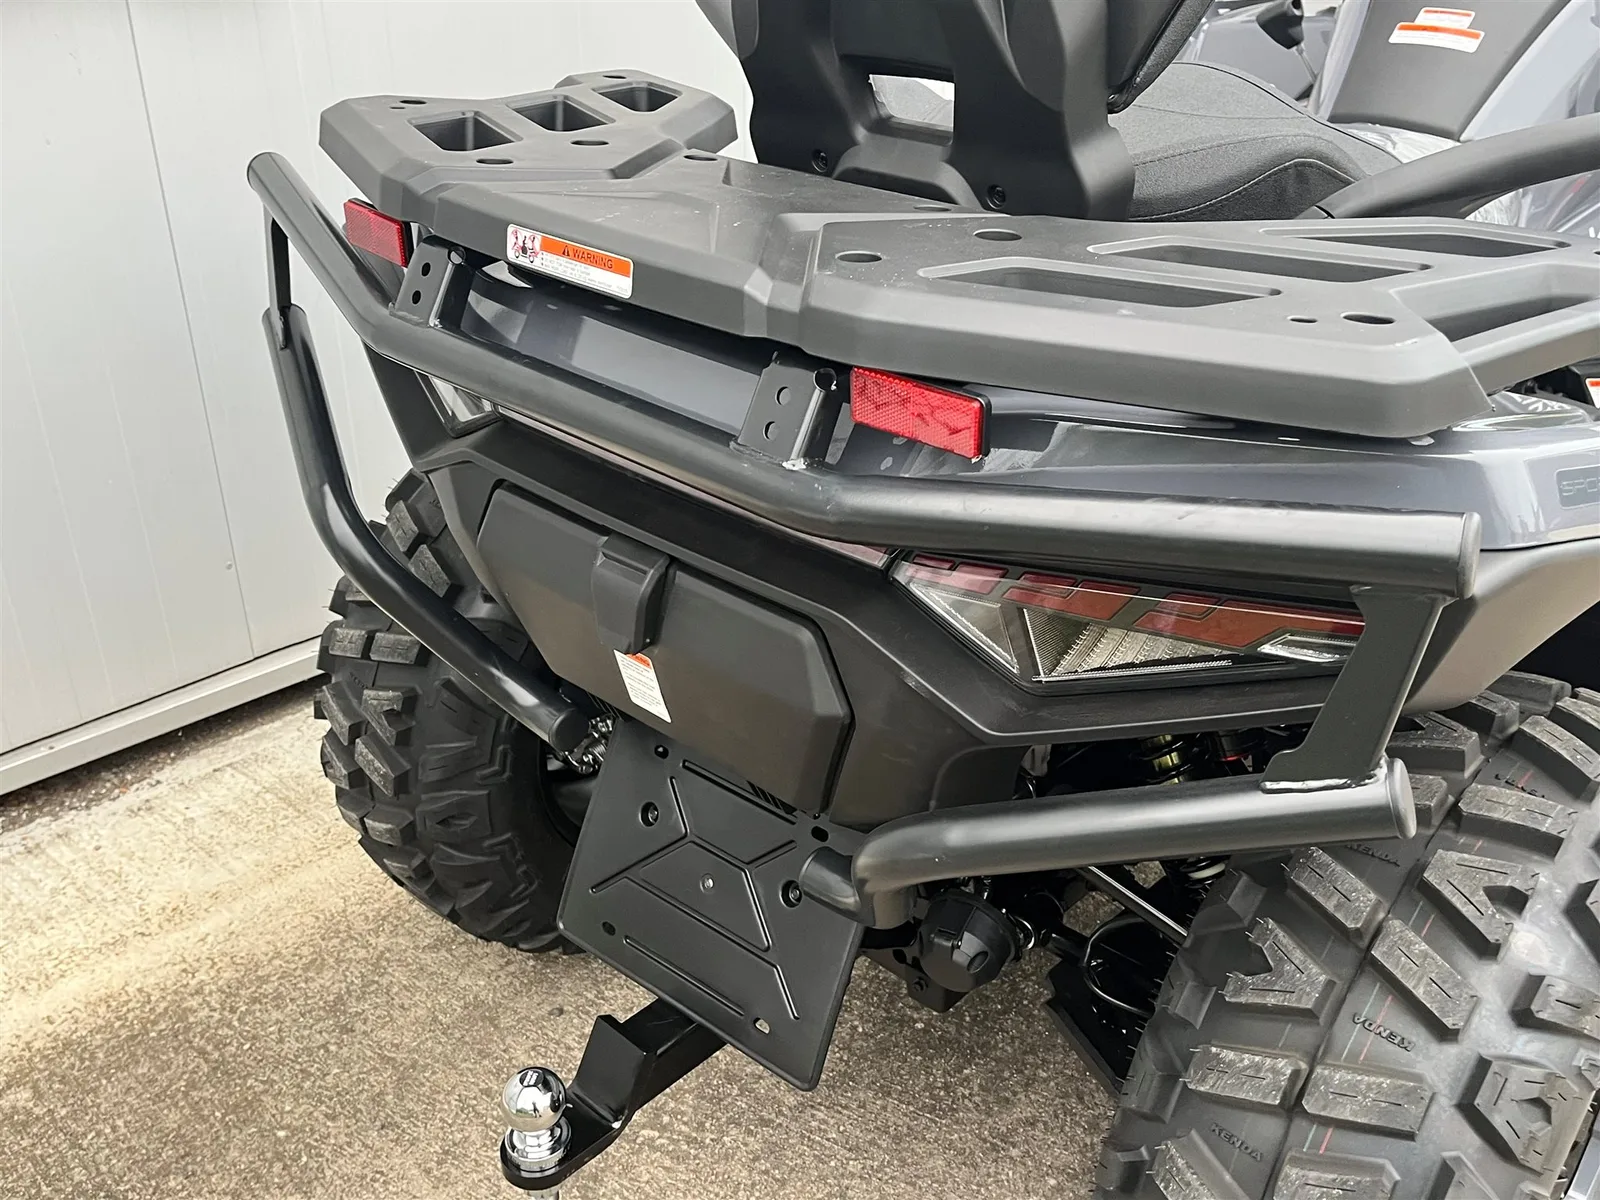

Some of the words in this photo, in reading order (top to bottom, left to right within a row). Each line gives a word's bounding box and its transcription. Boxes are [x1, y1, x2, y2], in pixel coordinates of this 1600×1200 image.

[572, 248, 613, 269] WARNING
[1561, 477, 1600, 496] SPO
[1352, 1012, 1416, 1052] KENDA
[1211, 1122, 1263, 1162] KENDA
